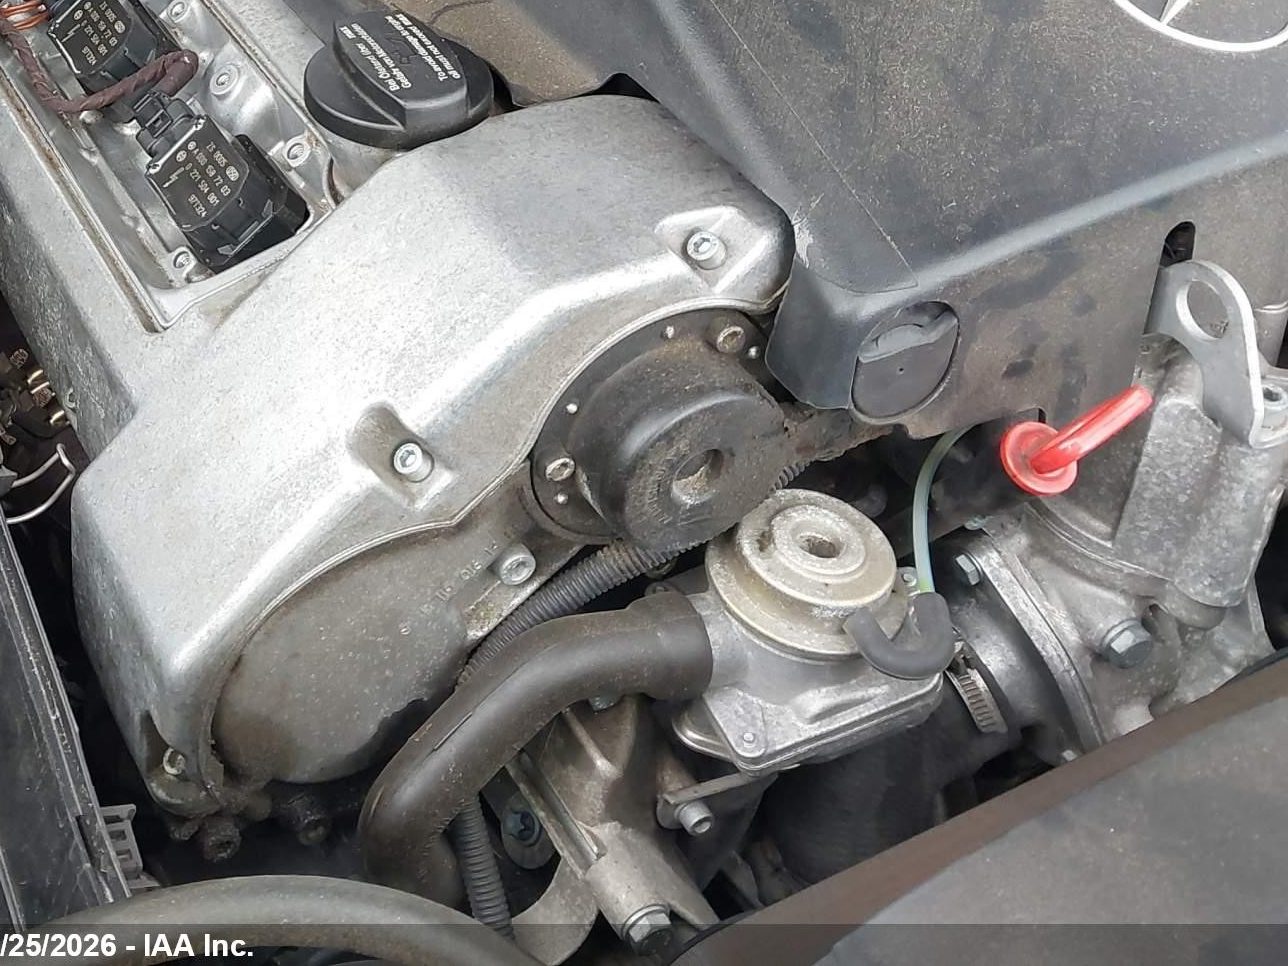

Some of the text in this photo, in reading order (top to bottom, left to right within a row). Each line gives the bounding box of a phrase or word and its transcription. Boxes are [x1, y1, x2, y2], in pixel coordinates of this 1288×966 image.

[340, 26, 357, 39] max
[409, 23, 432, 46] exceed
[406, 34, 428, 57] damage
[427, 43, 440, 56] not
[383, 55, 395, 68] von
[422, 53, 442, 72] avoid
[436, 53, 454, 71] must
[392, 68, 412, 89] Gefahr
[438, 70, 449, 82] To
[448, 68, 461, 79] oil
[385, 79, 400, 92] Bei
[214, 151, 228, 168] 0005
[190, 169, 202, 182] 221
[198, 180, 210, 194] 504
[207, 193, 220, 207] 001
[213, 176, 224, 187] 72
[221, 185, 231, 197] 03
